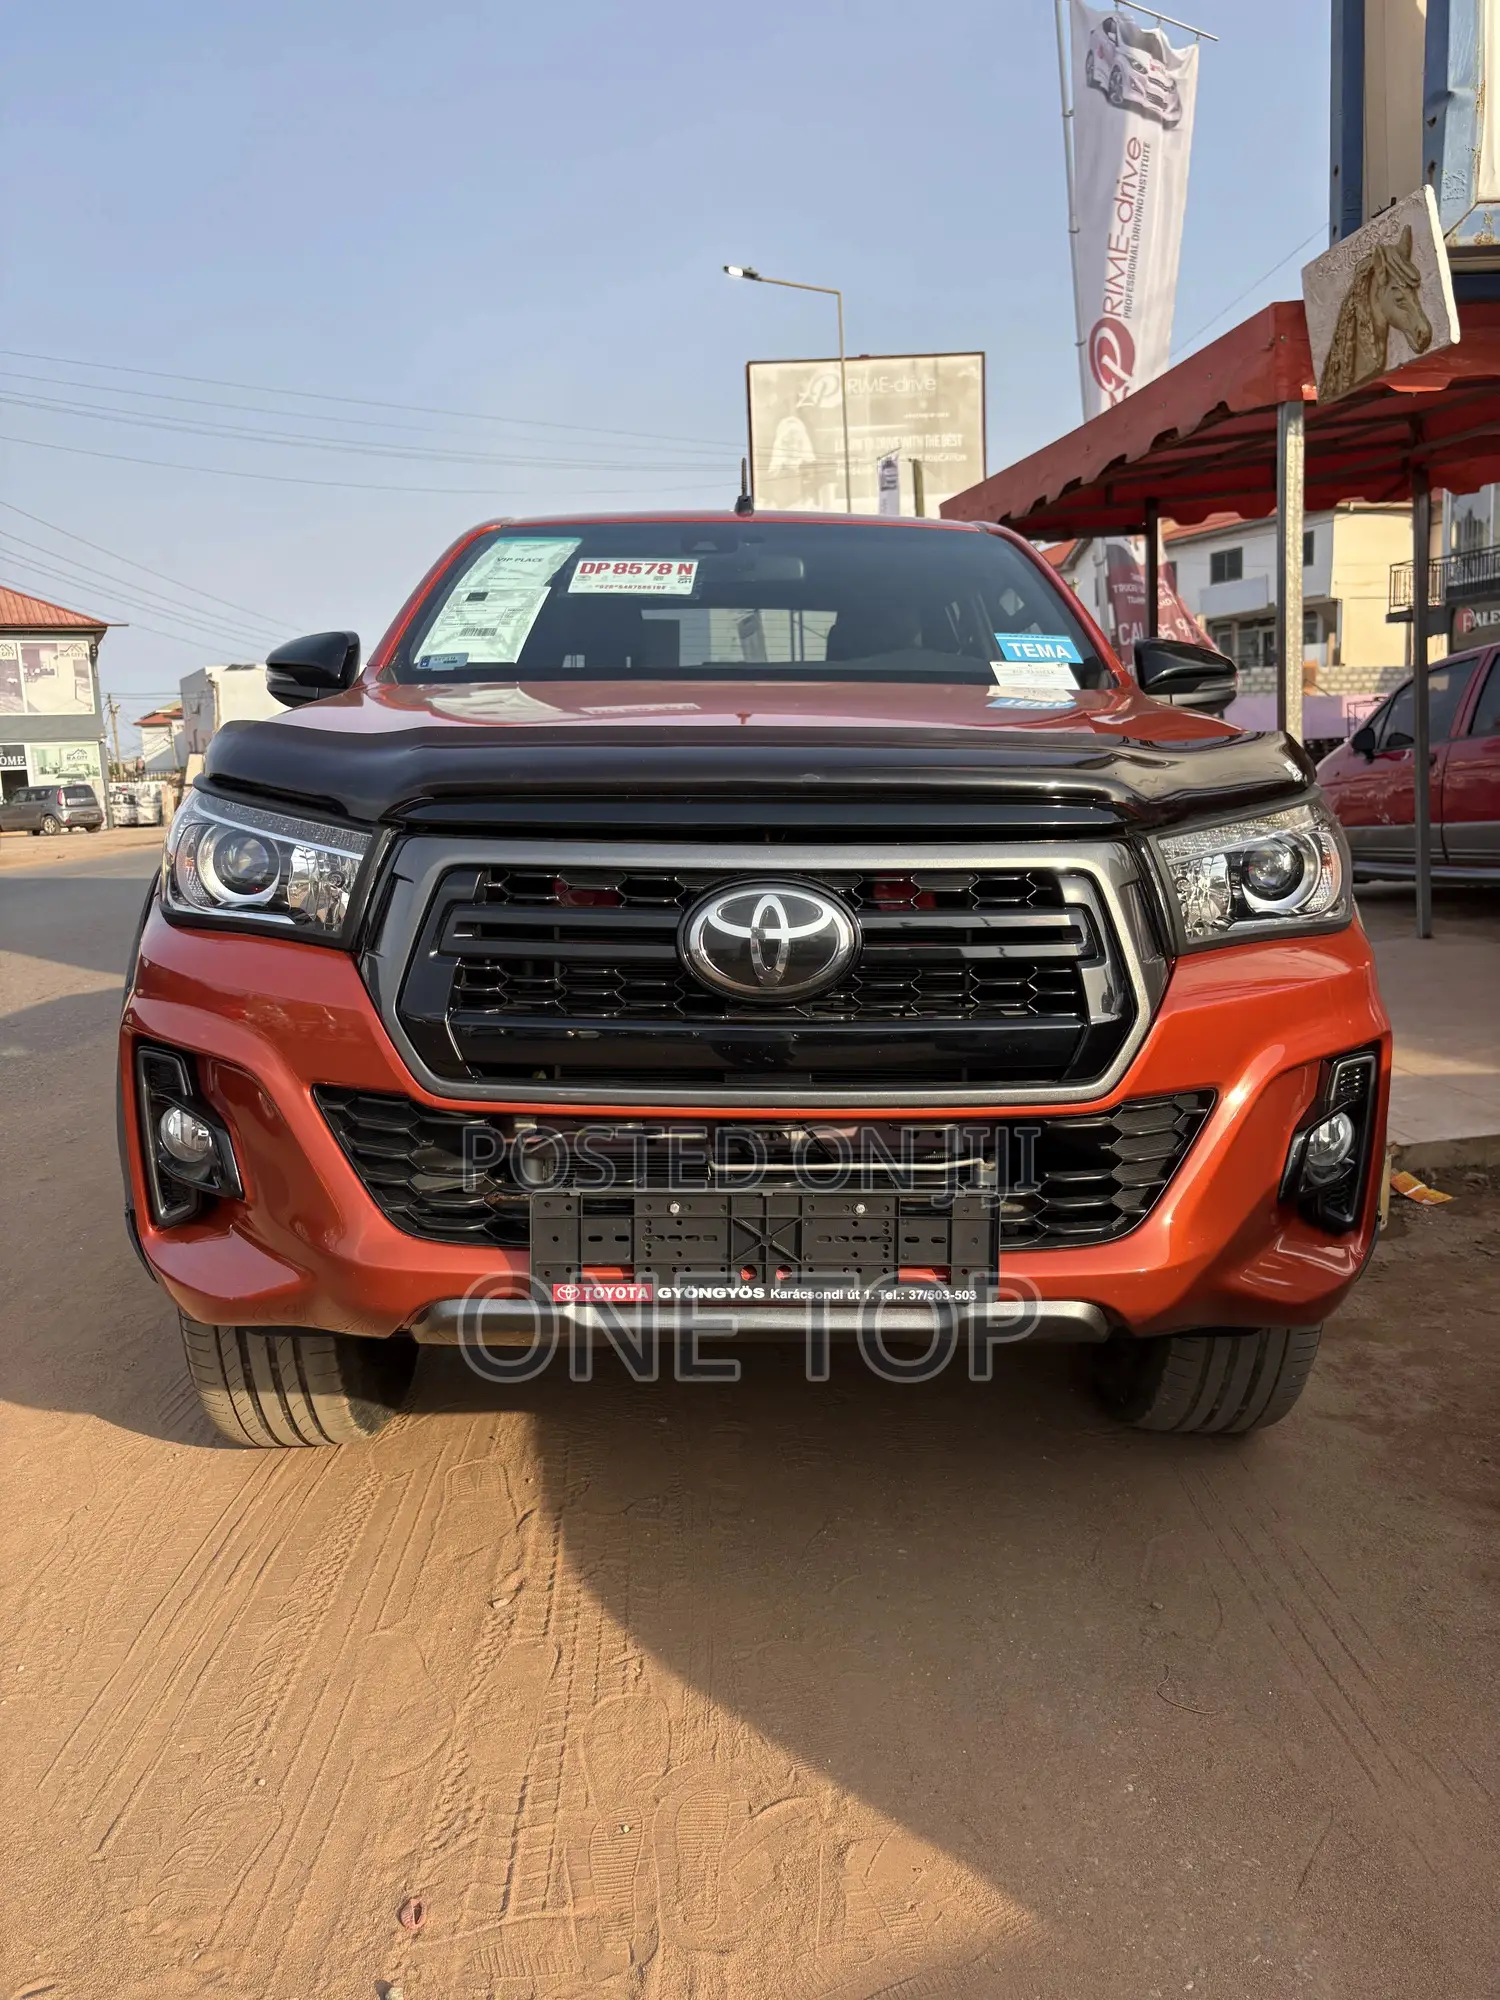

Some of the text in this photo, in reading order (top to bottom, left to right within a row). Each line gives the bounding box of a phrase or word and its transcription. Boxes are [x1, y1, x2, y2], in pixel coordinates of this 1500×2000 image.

[1123, 141, 1152, 319] PROFESSIONAL DRIVING INSTITUTE
[579, 562, 694, 575] DP 8578 N
[1007, 642, 1072, 659] TEMA
[583, 1285, 978, 1300] TOYOTA GYÖNGYÖS Karácsondi út 1. Tel.: 37/503-503
